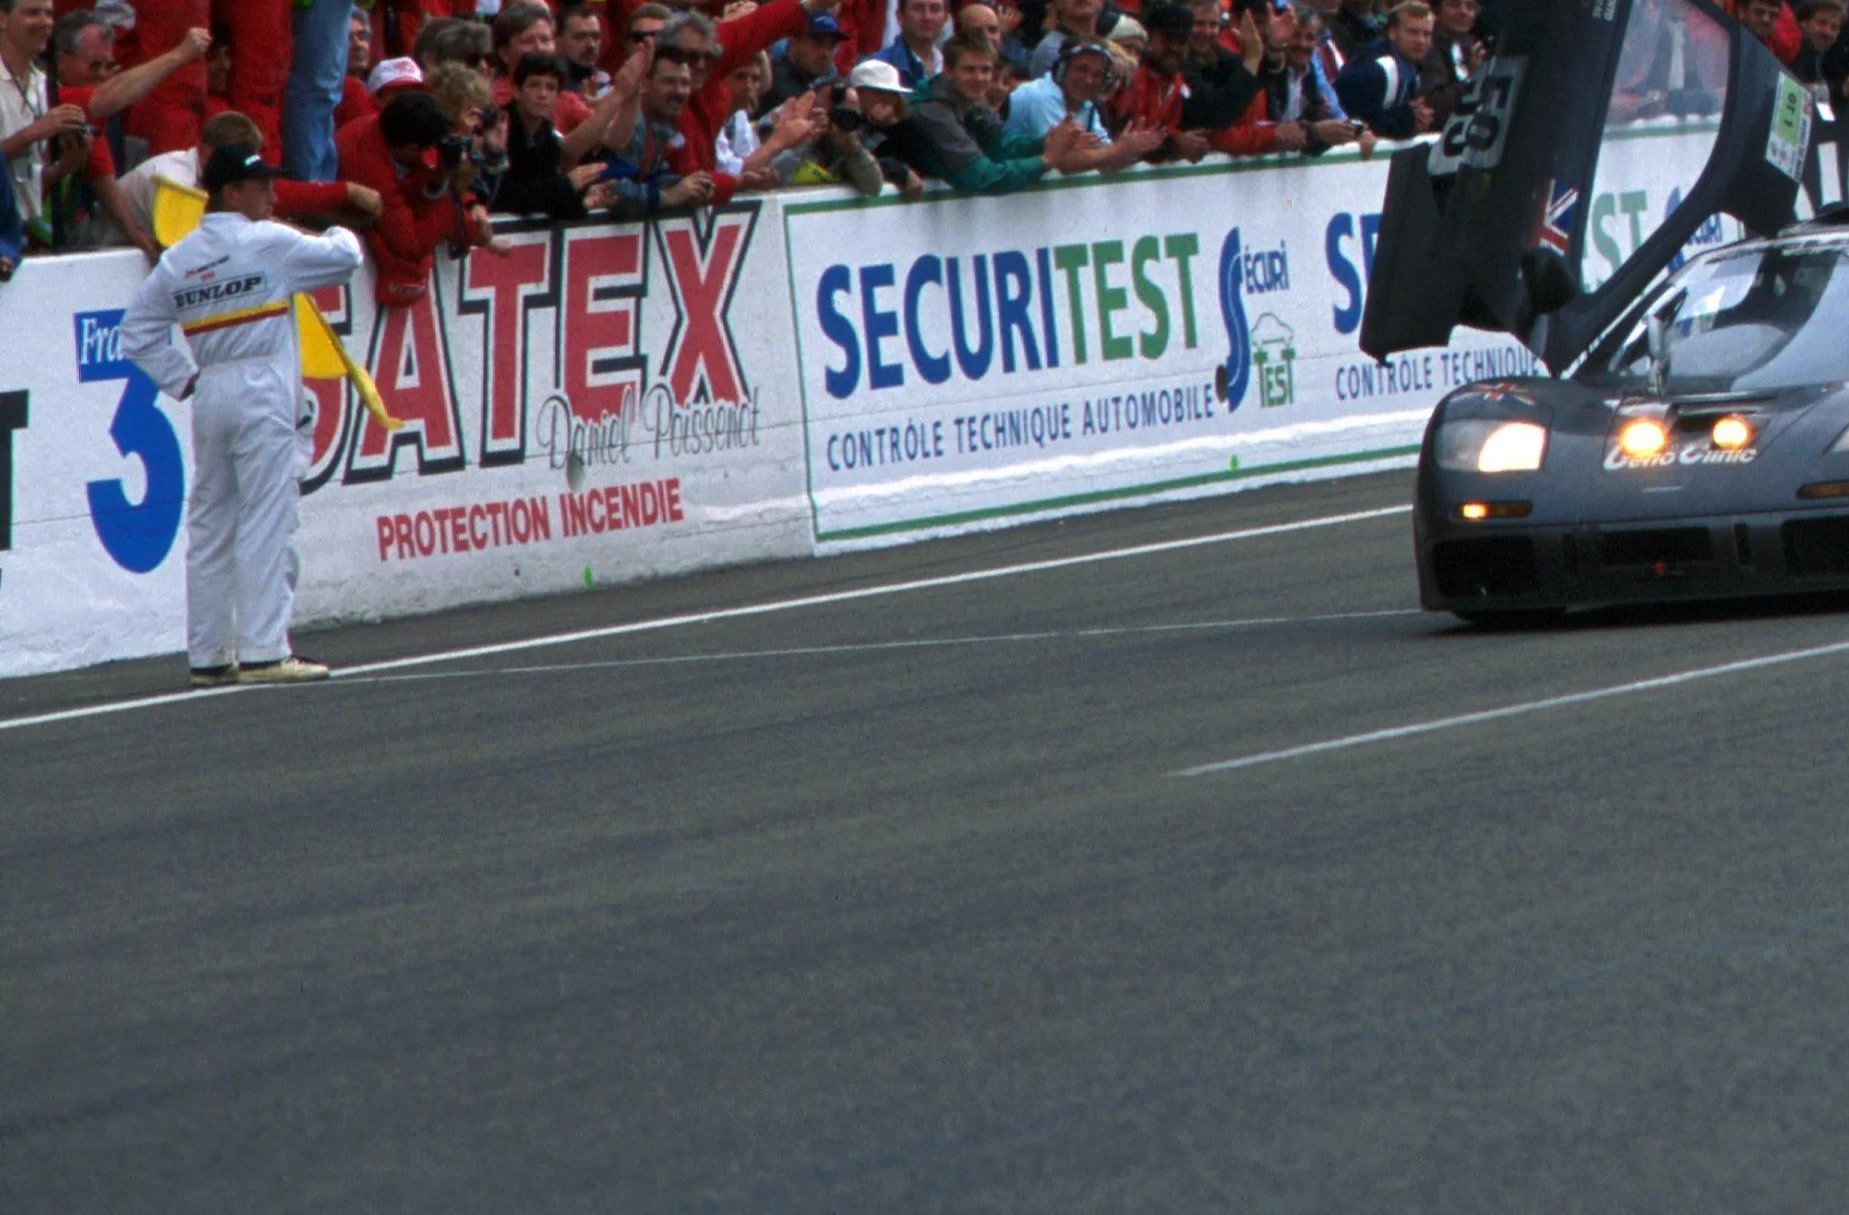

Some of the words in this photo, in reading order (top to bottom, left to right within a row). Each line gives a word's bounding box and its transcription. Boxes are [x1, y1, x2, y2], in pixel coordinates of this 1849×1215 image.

[174, 276, 262, 308] DUNLOP
[817, 233, 1199, 399] SECURITEST
[1253, 348, 1296, 408] TEST
[1441, 346, 1538, 387] TECHNIQUE
[73, 308, 184, 573] 3
[536, 385, 635, 470] Daniel
[827, 417, 943, 471] CONTRÔLE
[955, 403, 1071, 453] TECHNIQUE
[1083, 384, 1213, 436] AUTOMOBILE
[377, 495, 551, 562] PROTECTION
[560, 478, 684, 537] INCENDIE
